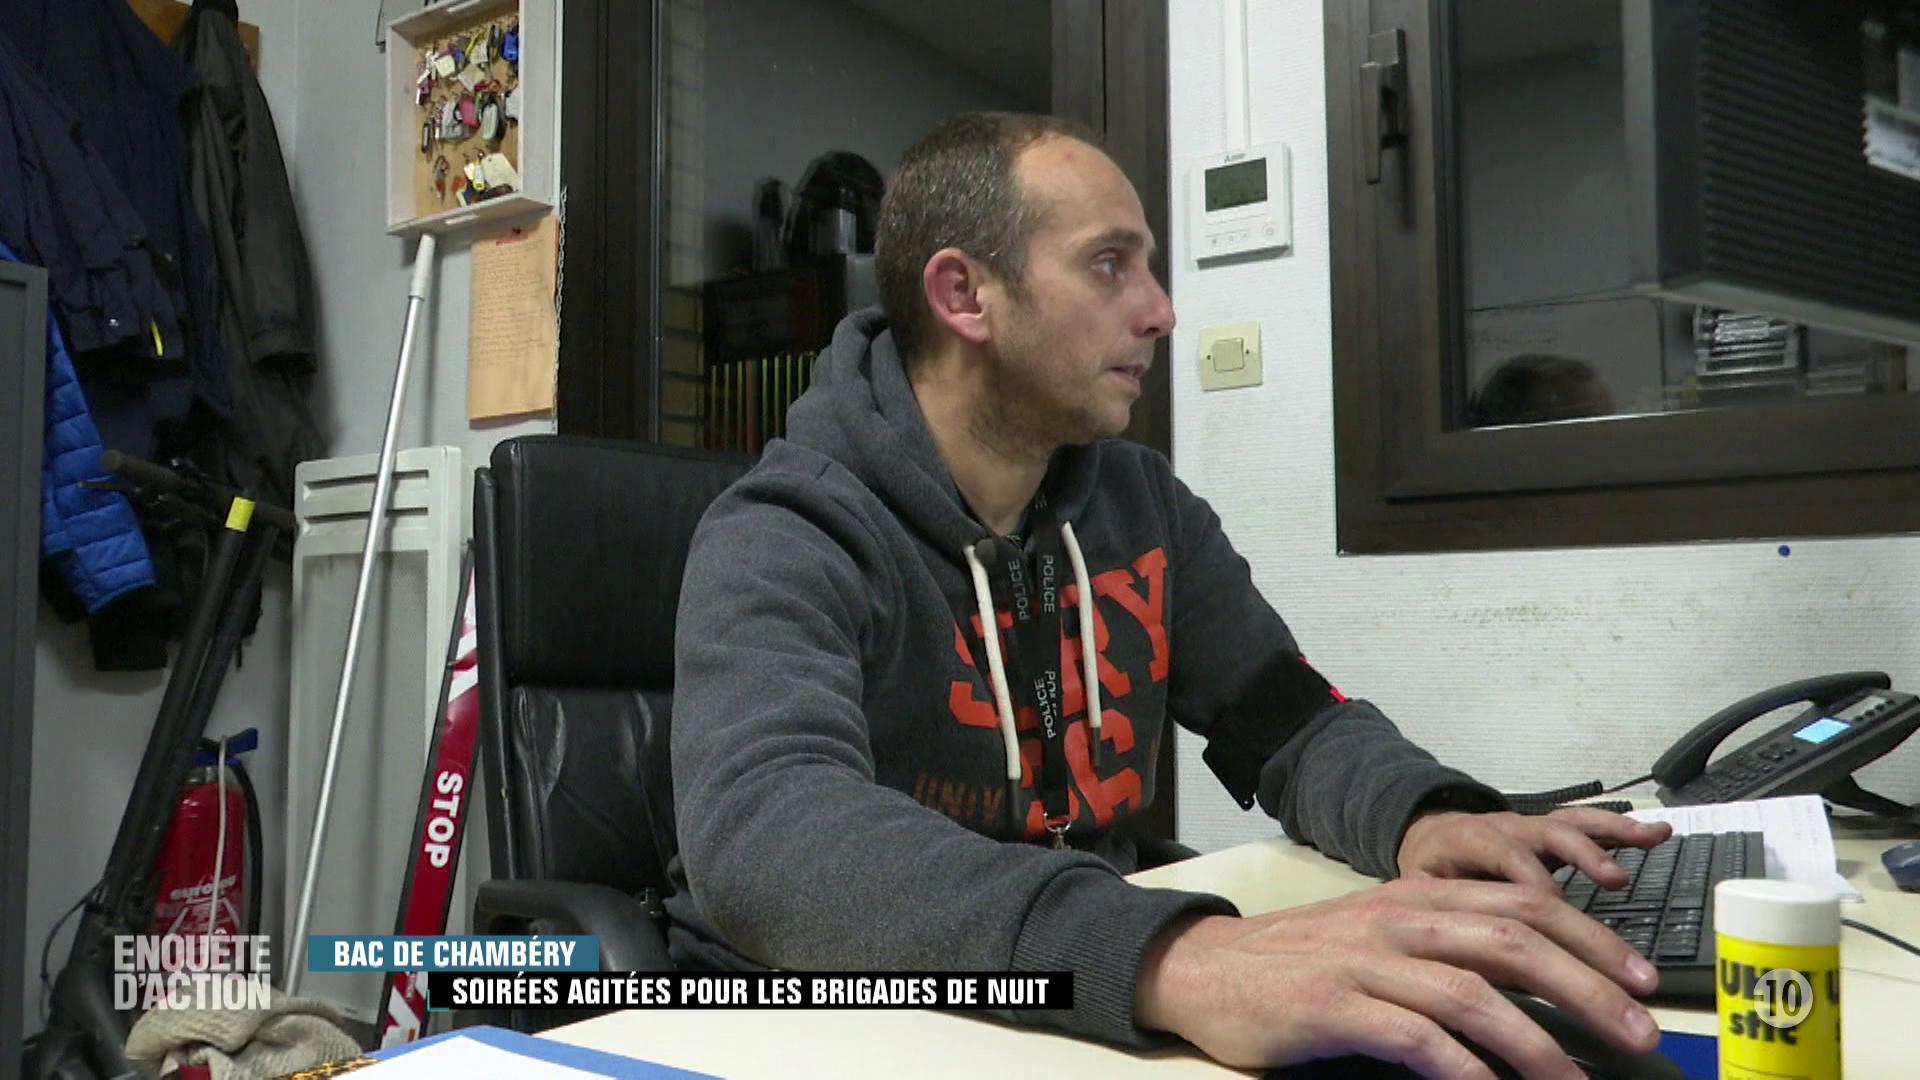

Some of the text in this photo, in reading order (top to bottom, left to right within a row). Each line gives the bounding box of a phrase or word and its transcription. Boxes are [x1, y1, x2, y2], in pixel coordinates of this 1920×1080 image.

[1008, 559, 1030, 621] POLICE
[1041, 554, 1055, 614] POLICE
[1034, 677, 1057, 739] POLICE
[424, 770, 464, 869] STOP
